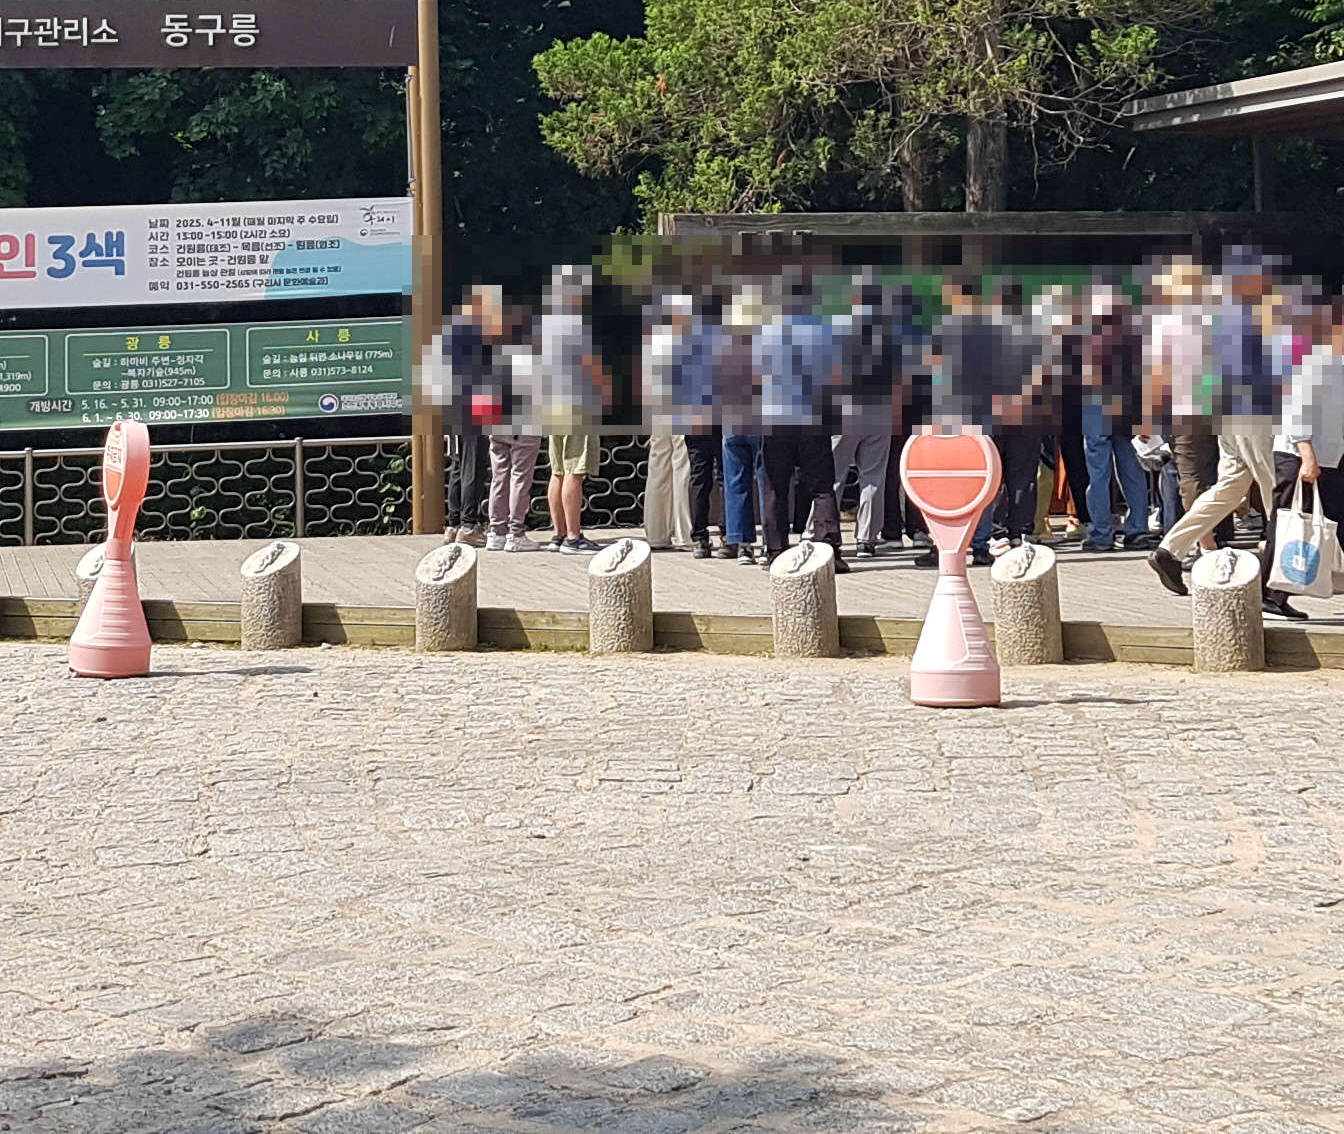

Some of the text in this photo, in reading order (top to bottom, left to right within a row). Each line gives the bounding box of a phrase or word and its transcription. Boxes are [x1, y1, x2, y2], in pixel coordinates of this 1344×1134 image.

[159, 13, 261, 47] 동구릉
[148, 214, 339, 229] 날짜 2025. 4-11월 (매월 마지막 주 수요일)
[148, 232, 170, 242] 시간
[240, 229, 268, 240] (2시간
[269, 228, 291, 239] 소요)
[46, 230, 126, 278] 3색
[148, 244, 170, 254] 코스
[148, 257, 170, 267] 장소
[176, 255, 206, 266] 모이는
[148, 281, 170, 291] 예약
[176, 279, 250, 290] 031-550-2565
[252, 278, 281, 289] (구리시
[120, 356, 148, 367] 하마비
[328, 350, 363, 362] 소나무길
[365, 349, 394, 360] (775m)
[263, 368, 281, 379] 문의
[311, 365, 373, 377] 031)573-8124
[92, 380, 111, 390] 문의
[142, 377, 205, 389] 031)527-7105
[29, 399, 73, 412] 개방시간
